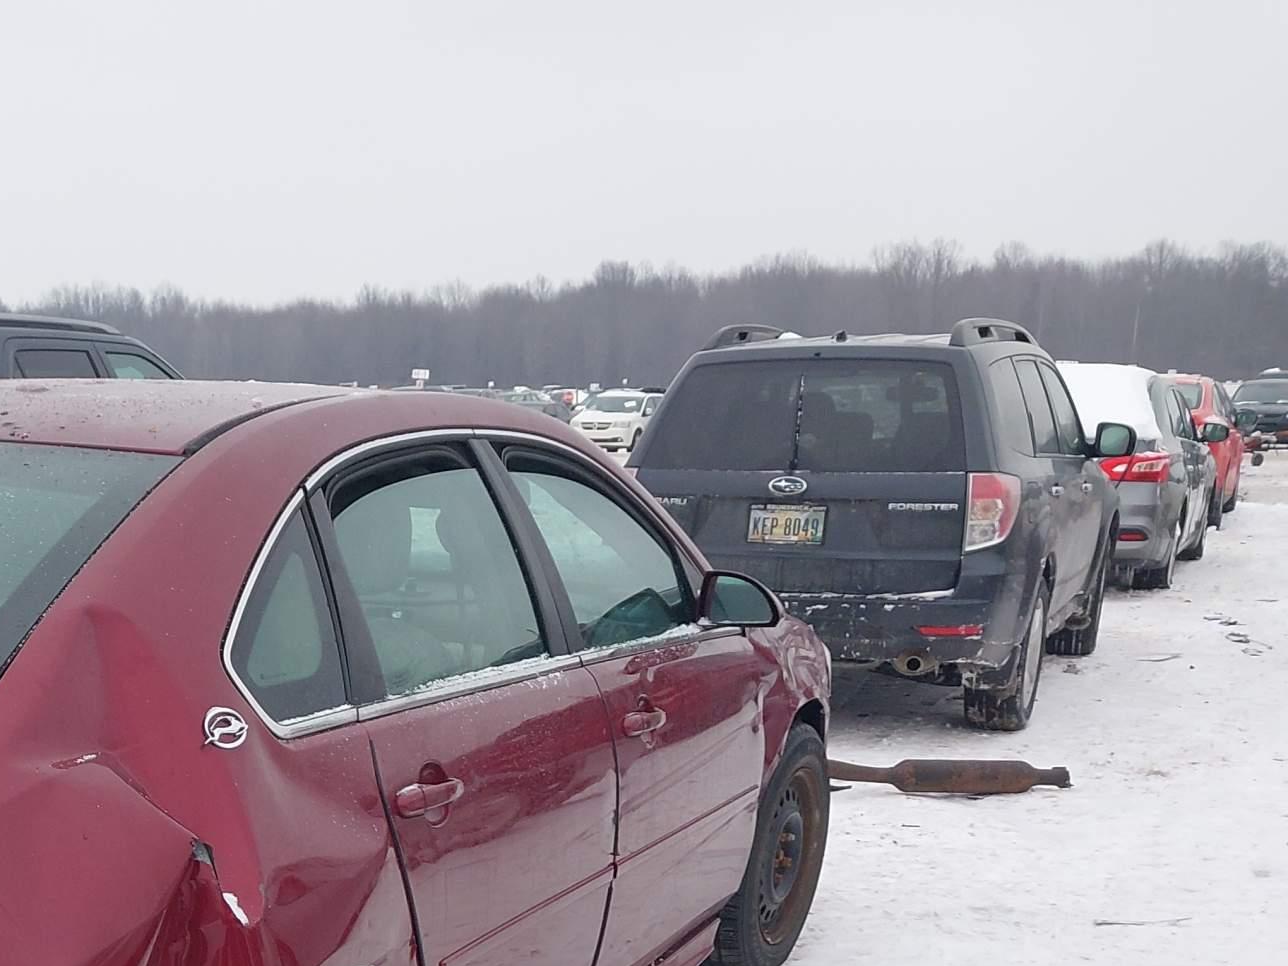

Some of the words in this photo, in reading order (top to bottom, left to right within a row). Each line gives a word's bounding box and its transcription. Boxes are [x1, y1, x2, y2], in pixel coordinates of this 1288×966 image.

[887, 502, 959, 511] FORESTER
[752, 516, 779, 536] KEP
[783, 517, 820, 536] 8049
